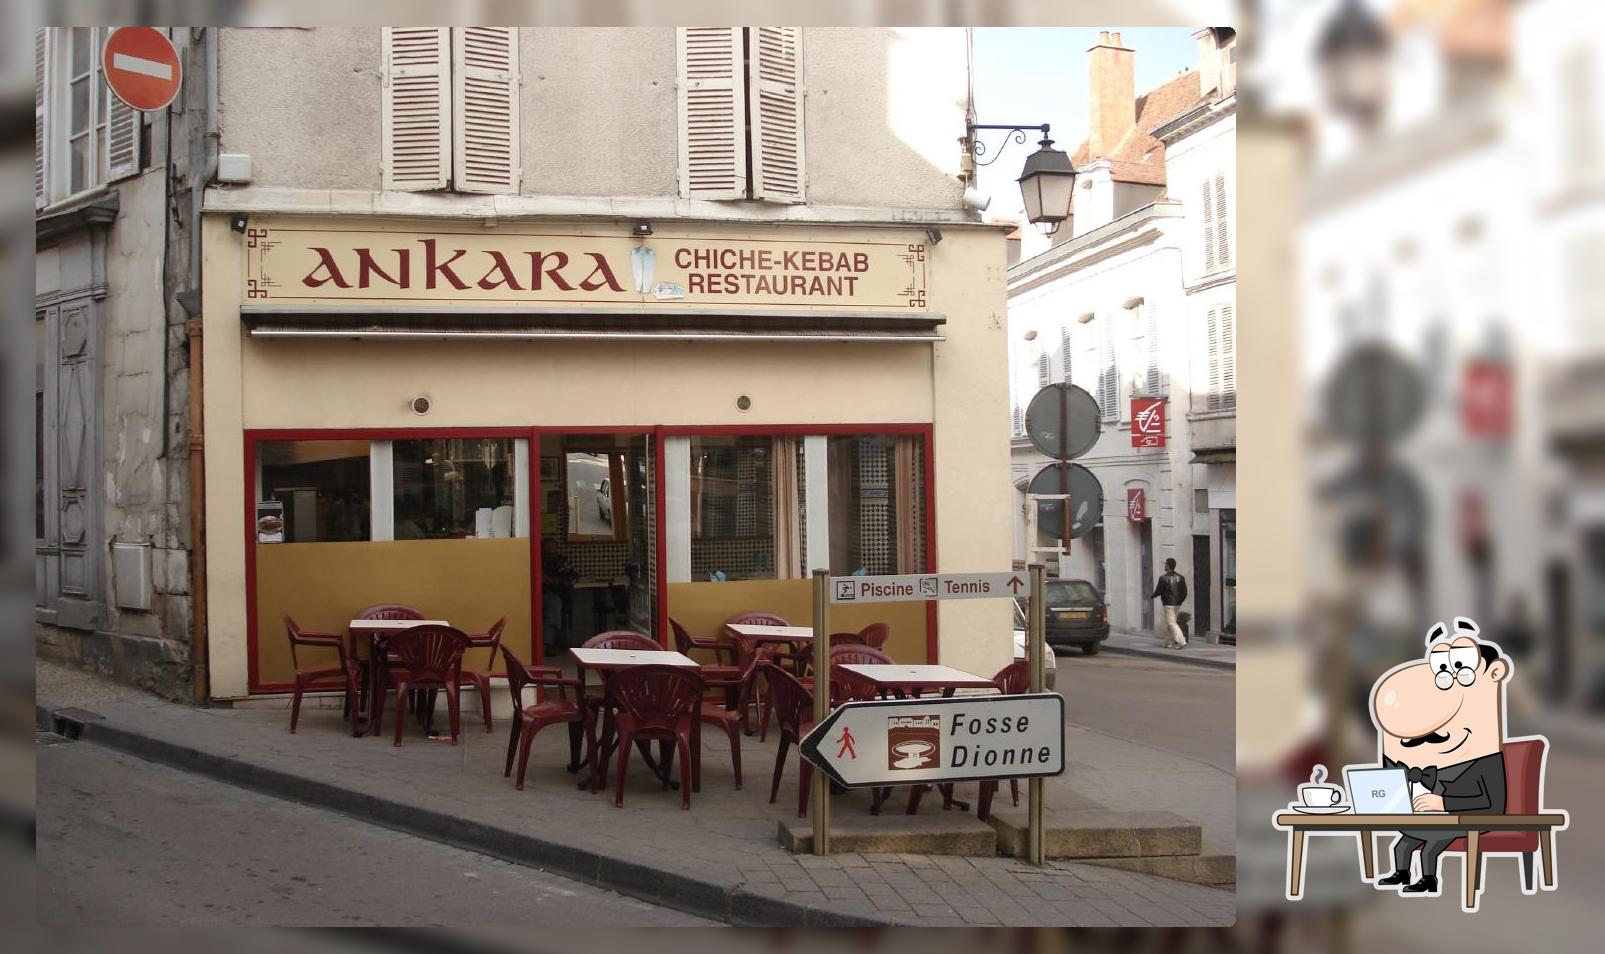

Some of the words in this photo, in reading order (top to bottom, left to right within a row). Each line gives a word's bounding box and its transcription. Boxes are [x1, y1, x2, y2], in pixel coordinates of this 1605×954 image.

[302, 239, 627, 292] ANKARA
[674, 248, 869, 273] CHICHE-KEBAB
[688, 273, 859, 296] RESTAURANT
[861, 582, 914, 597] Piscine
[944, 579, 991, 594] Tennis
[950, 713, 1029, 736] Fosse
[951, 744, 1051, 768] Dionne
